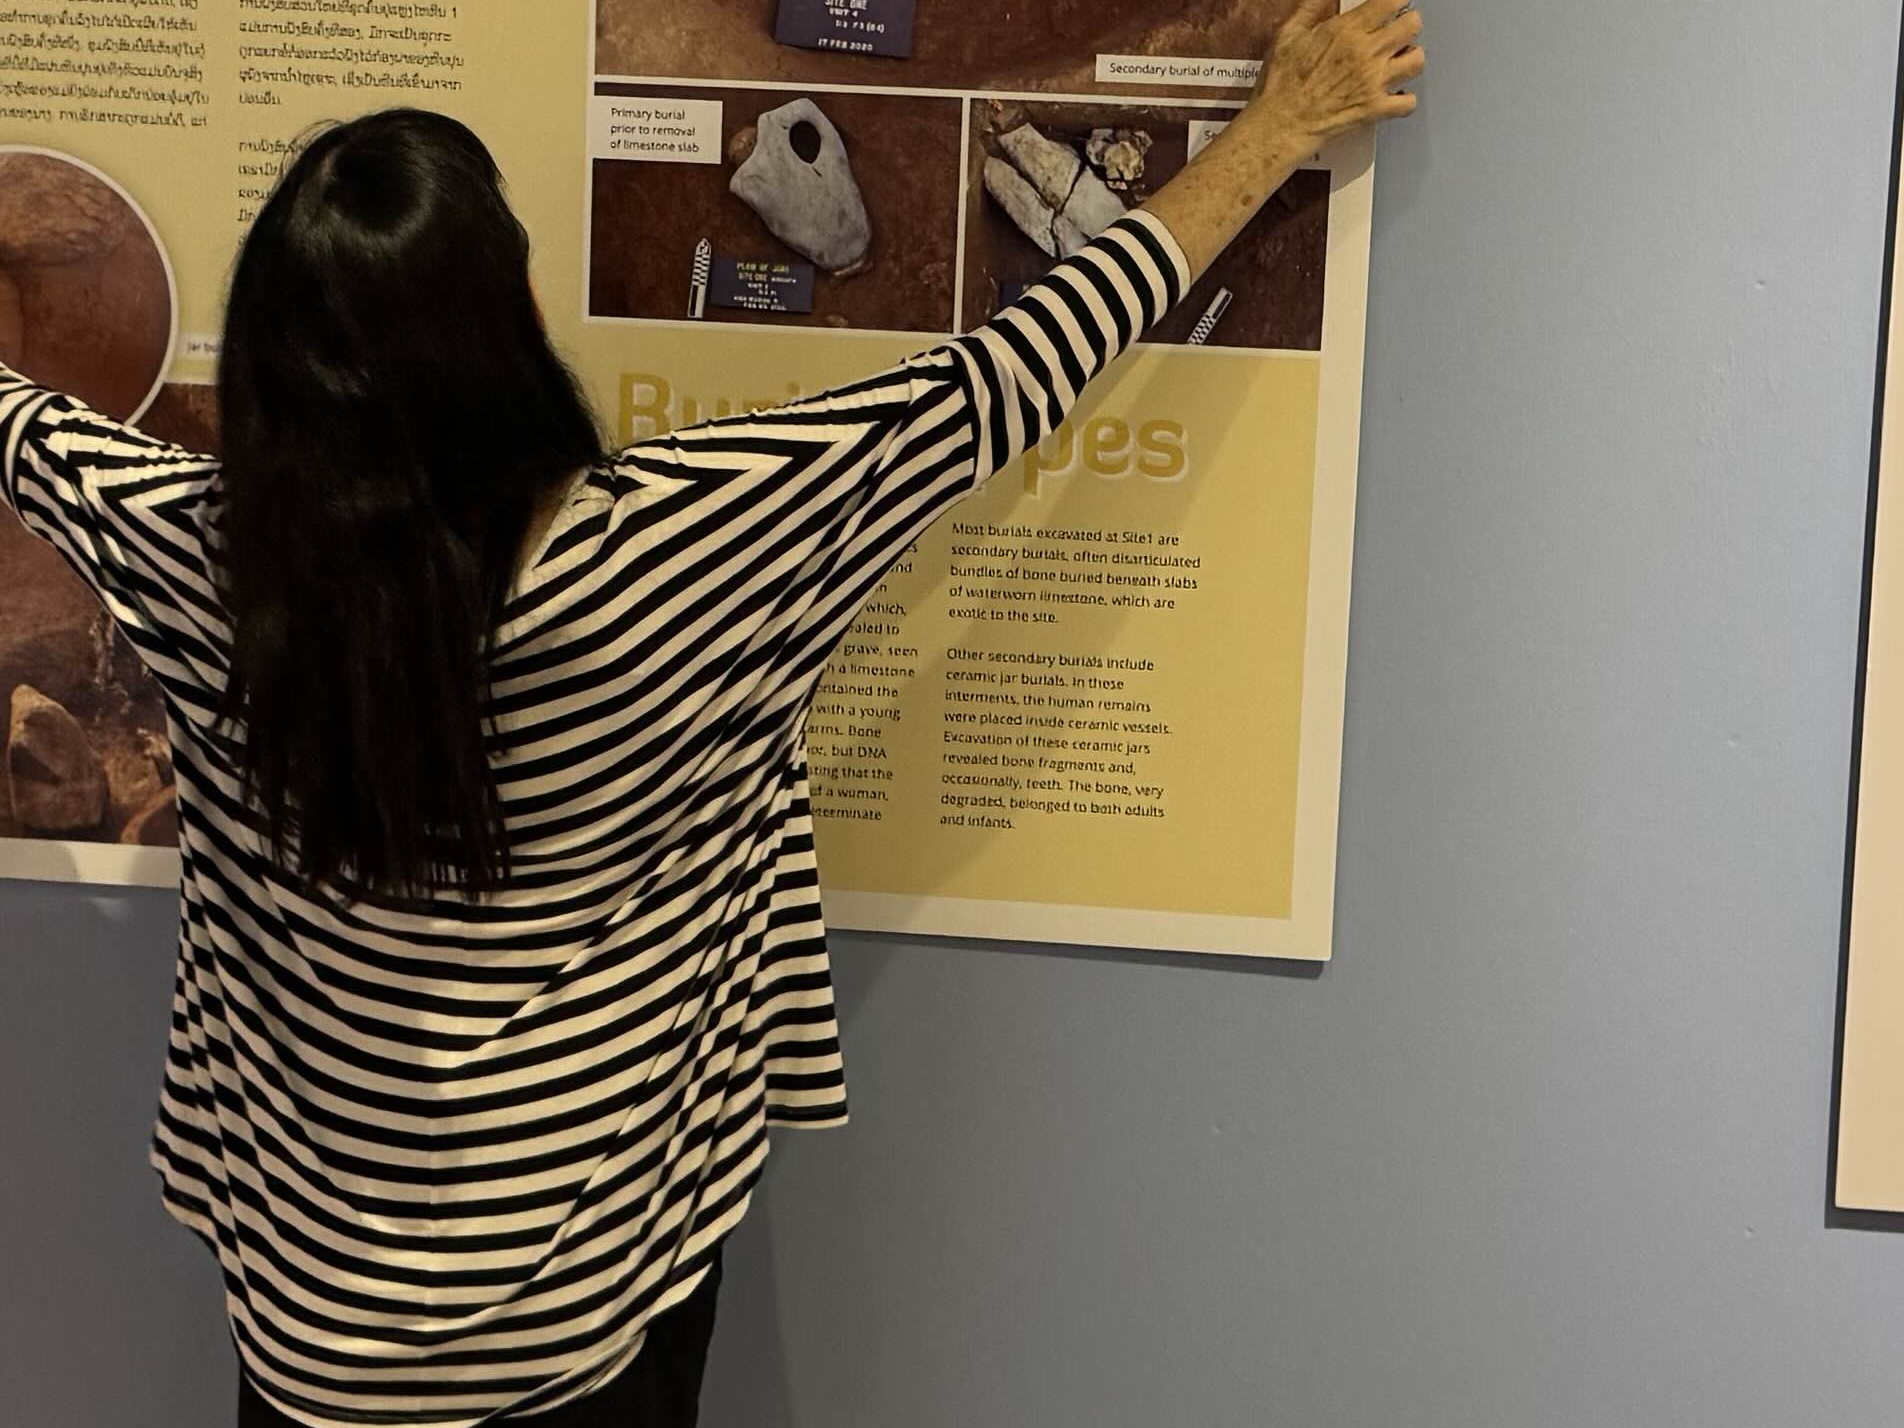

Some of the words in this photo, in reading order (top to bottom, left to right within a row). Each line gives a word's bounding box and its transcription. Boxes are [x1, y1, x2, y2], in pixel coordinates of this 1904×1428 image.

[1110, 63, 1166, 77] Secondary
[1169, 66, 1200, 76] burial
[1203, 66, 1214, 76] of
[611, 108, 652, 121] Primary
[655, 110, 685, 120] burial
[611, 126, 635, 135] prior
[639, 126, 649, 134] to
[653, 127, 695, 136] removal
[611, 140, 621, 148] of
[624, 140, 675, 151] limestone
[678, 142, 699, 152] slab
[953, 523, 984, 535] Most
[988, 524, 1032, 537] burials
[1037, 530, 1101, 541] excavated
[1106, 533, 1118, 543] at
[1158, 536, 1178, 546] are
[952, 546, 1018, 560] secondary
[1074, 550, 1107, 563] often
[1112, 553, 1200, 568] disarticulated
[950, 564, 1003, 578] bundles
[1006, 567, 1019, 579] of
[1023, 568, 1056, 581] bone
[1060, 571, 1102, 584] buried
[1107, 573, 1160, 586] beneath
[1165, 576, 1197, 589] slabs
[950, 585, 962, 596] of
[966, 588, 1036, 600] waterworn
[1112, 595, 1150, 607] which
[1154, 599, 1174, 609] are
[949, 608, 987, 620] exotic
[991, 610, 1003, 620] to
[1008, 610, 1028, 622] the
[947, 649, 984, 660] Other
[988, 652, 1055, 668] secondary
[1059, 654, 1102, 668] burials
[1107, 658, 1154, 671] include
[946, 672, 996, 683] ceramic
[1000, 672, 1018, 686] jar
[1073, 677, 1084, 688] In
[1088, 678, 1124, 690] these
[945, 713, 976, 722] were
[980, 713, 1022, 725] placed
[1068, 720, 1119, 731] ceramic
[1010, 797, 1070, 813] belonged
[1074, 803, 1087, 812] to
[1091, 802, 1121, 814] both
[1125, 805, 1164, 817] adults
[940, 815, 964, 825] and
